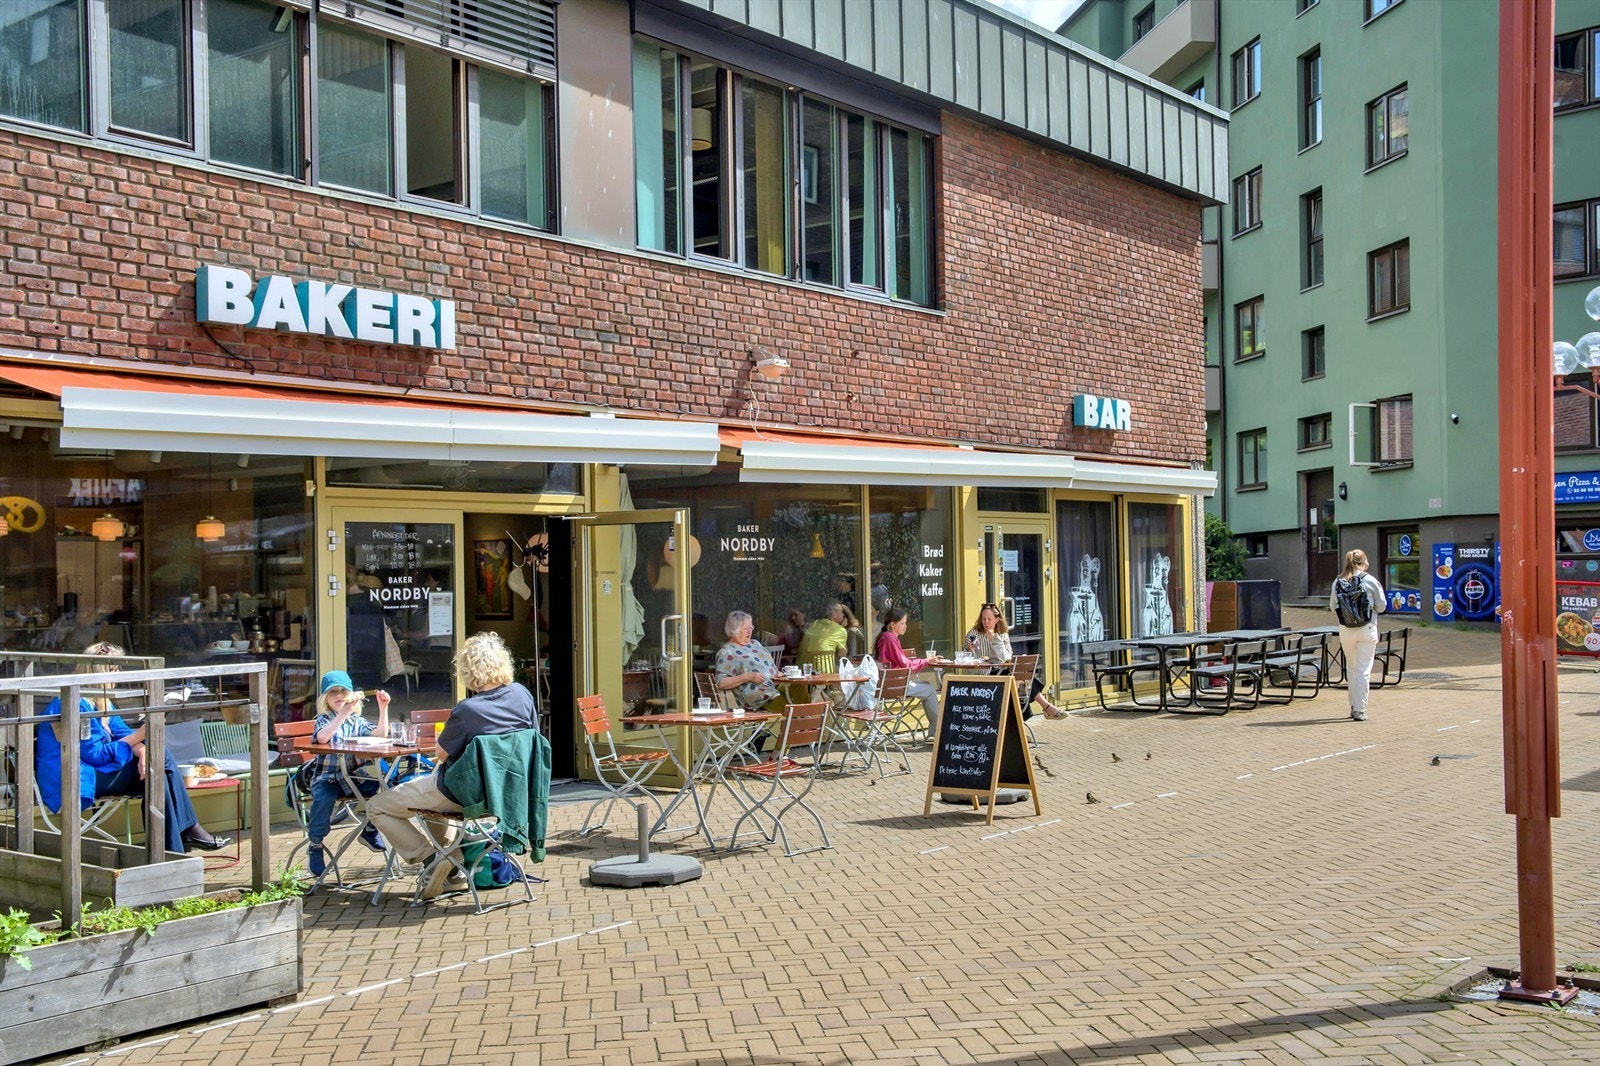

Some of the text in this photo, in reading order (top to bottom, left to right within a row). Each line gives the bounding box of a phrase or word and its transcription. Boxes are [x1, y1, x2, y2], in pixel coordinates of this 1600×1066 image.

[199, 265, 456, 350] BAKERI
[1079, 394, 1131, 431] BAR
[1568, 476, 1591, 488] Pizza
[737, 524, 760, 533] BAKER
[720, 537, 776, 552] NORDBY
[924, 545, 944, 558] Brød
[919, 564, 944, 577] Kaker
[388, 576, 413, 584] BAKER
[369, 587, 431, 602] NORDBY
[921, 583, 944, 597] Kaffe
[1561, 596, 1598, 607] KEBAB
[950, 685, 998, 701] BAKER NORDBY
